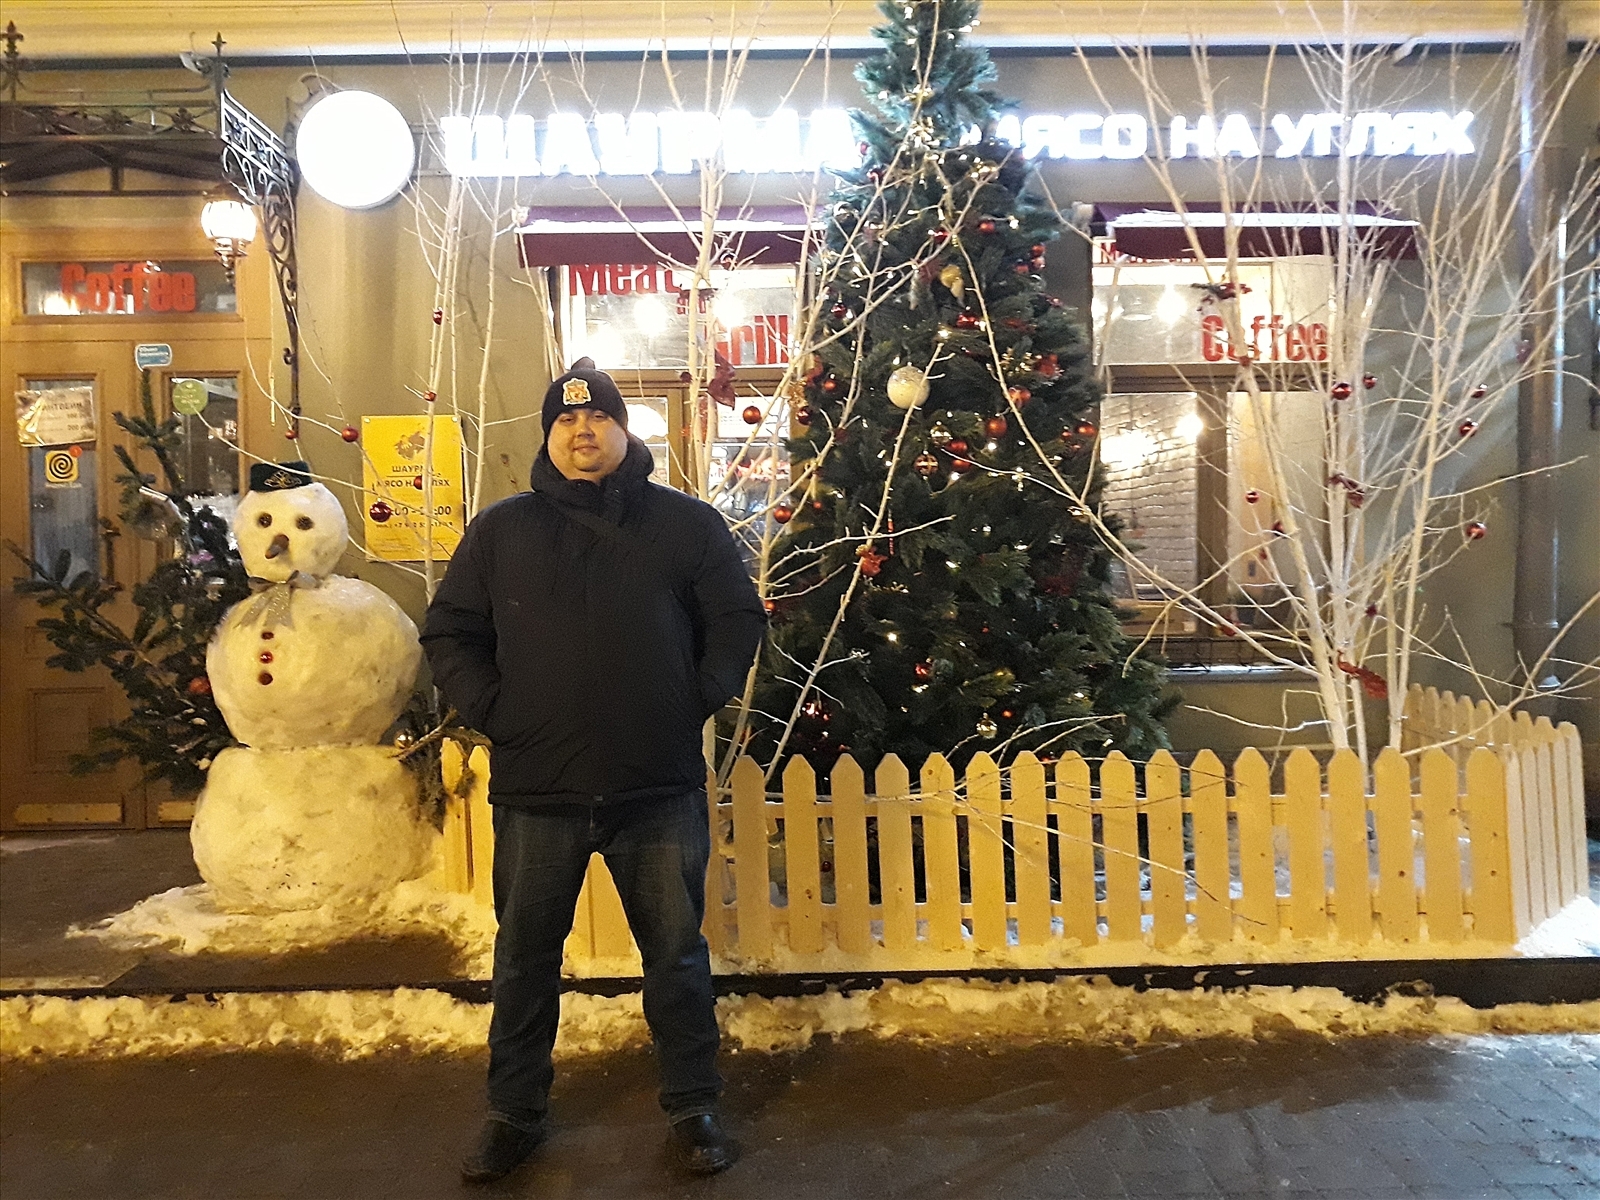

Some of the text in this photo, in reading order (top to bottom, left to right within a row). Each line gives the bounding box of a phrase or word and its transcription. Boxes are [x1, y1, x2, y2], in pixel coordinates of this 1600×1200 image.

[440, 108, 861, 176] ШАУРМА
[1170, 112, 1260, 159] НА
[1271, 110, 1476, 158] УГЛЯХ
[61, 262, 196, 313] Coffee
